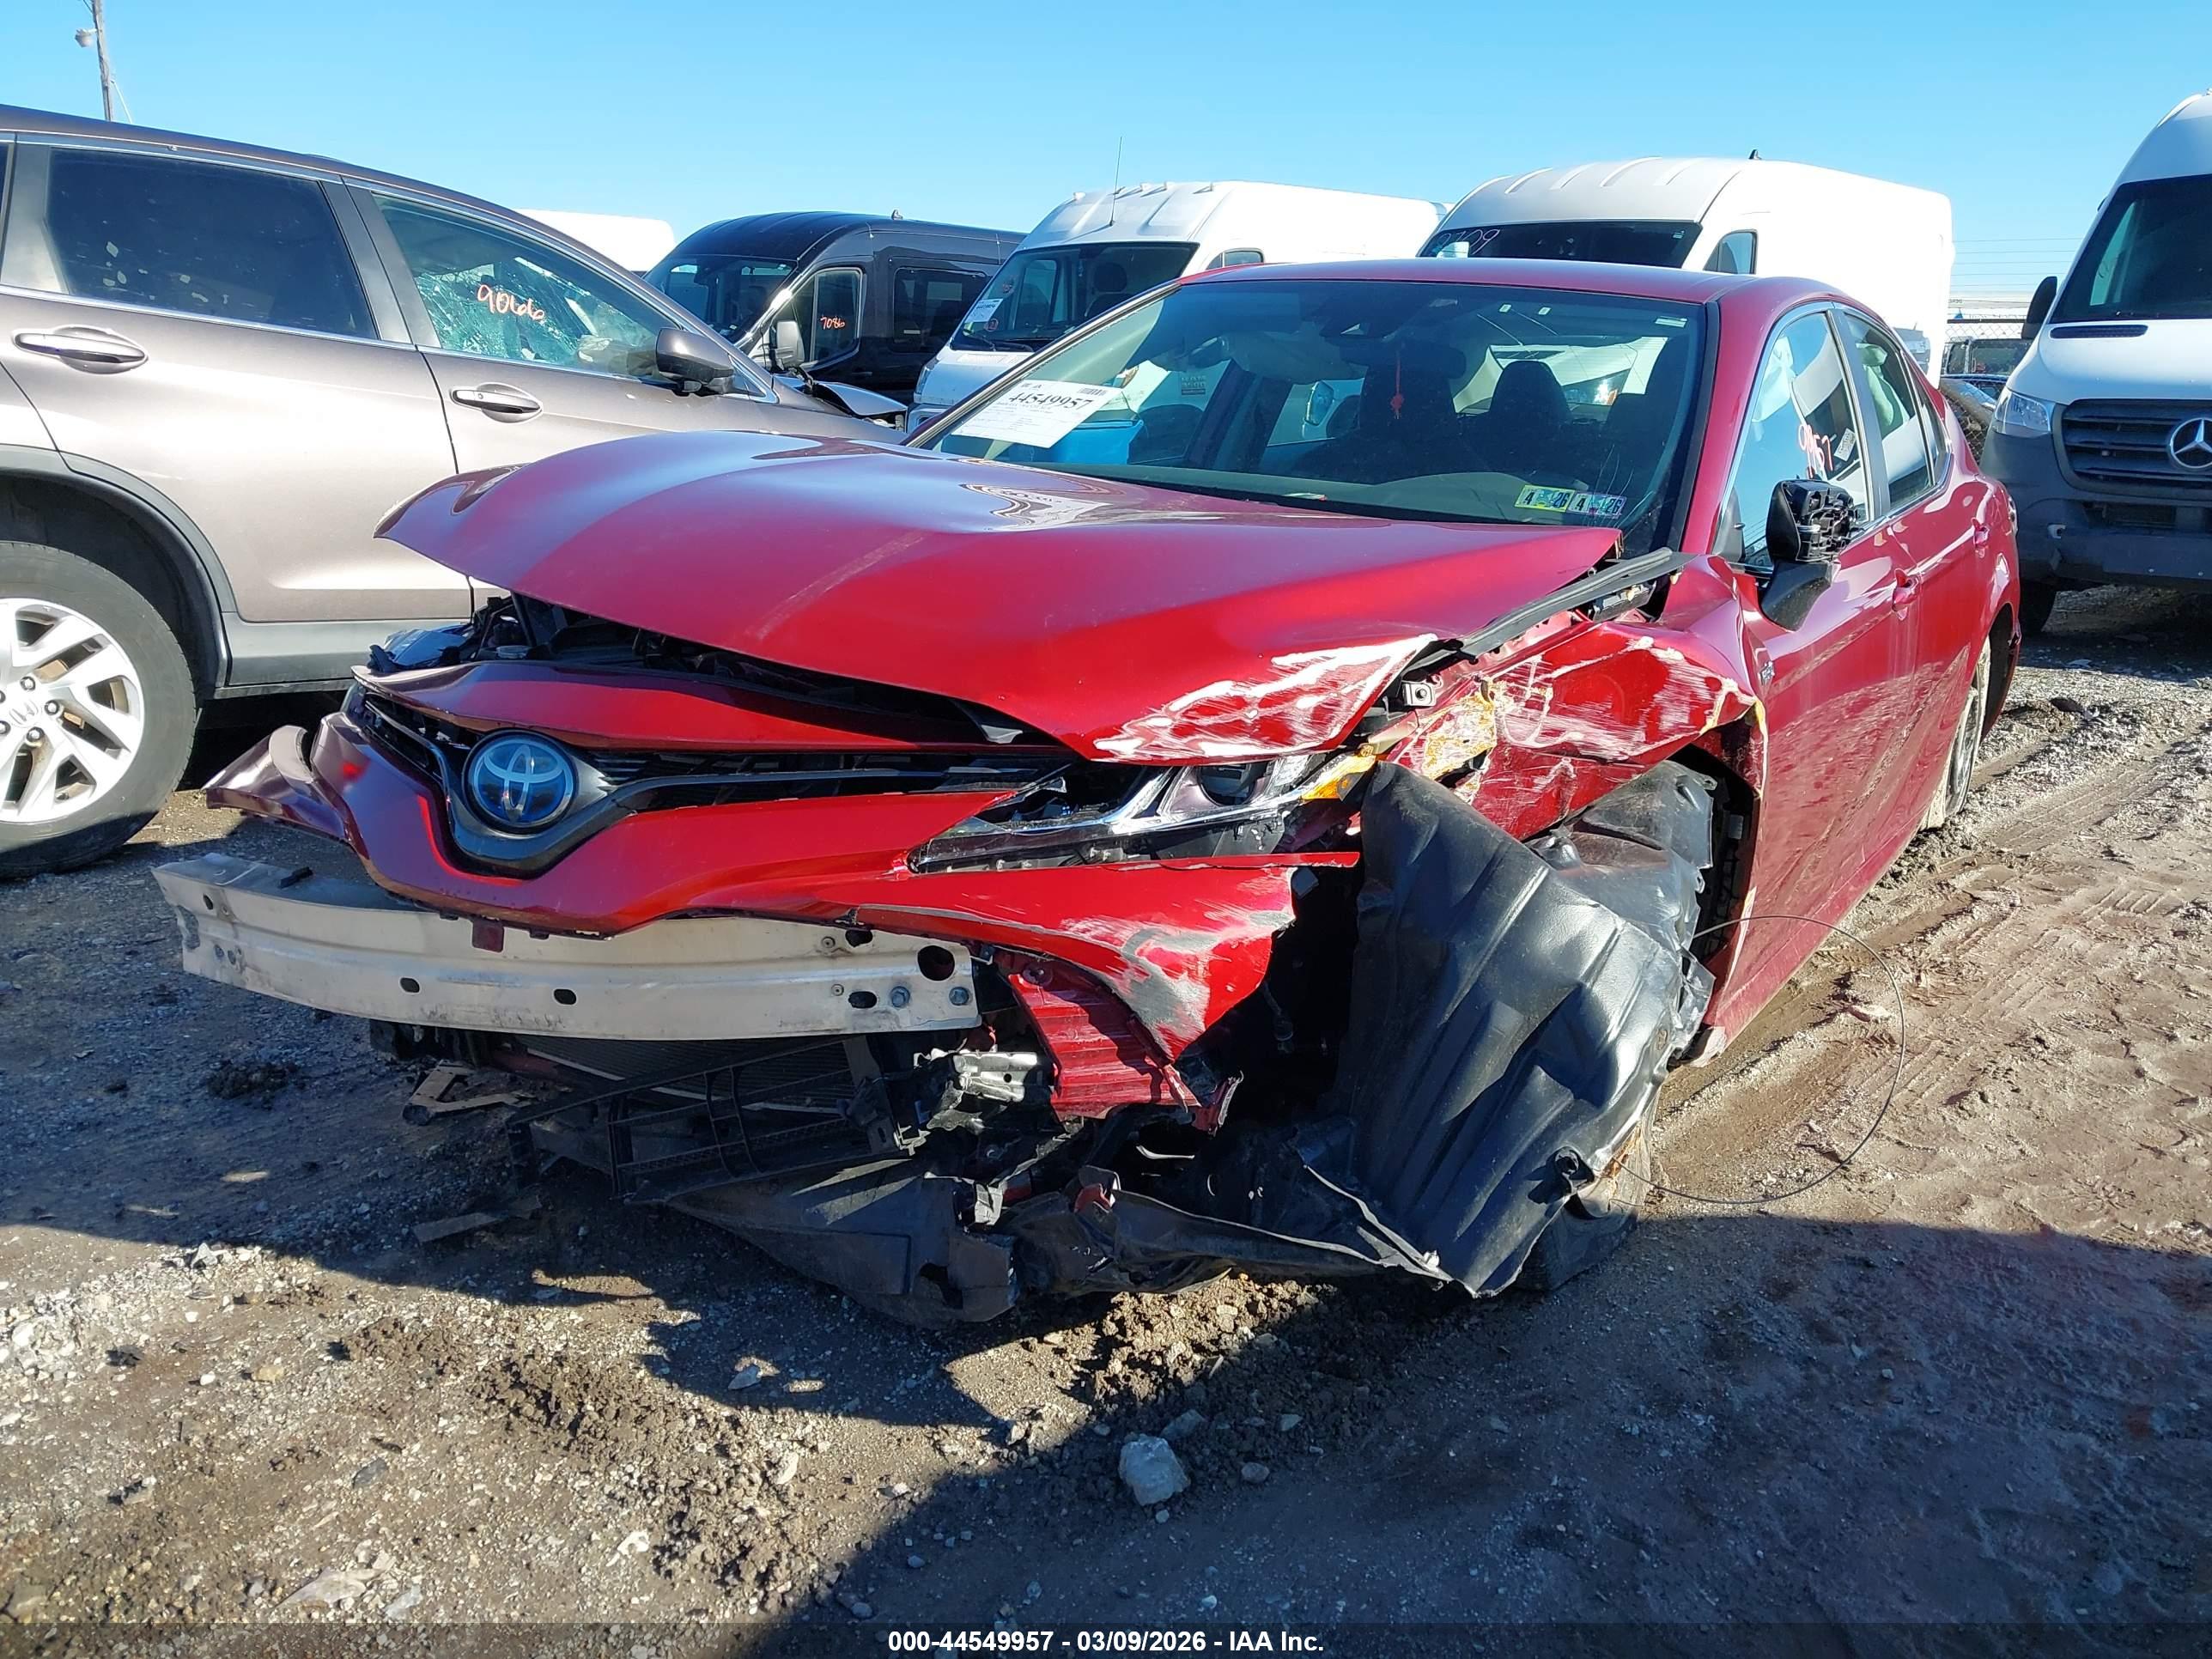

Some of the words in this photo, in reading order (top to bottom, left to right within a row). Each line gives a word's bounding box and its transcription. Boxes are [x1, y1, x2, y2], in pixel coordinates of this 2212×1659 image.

[477, 284, 545, 321] 9066
[820, 315, 846, 331] 7086
[1008, 392, 1095, 410] 44549957
[1524, 492, 1535, 505] 4
[1553, 492, 1571, 508] 26
[1575, 498, 1586, 511] 4
[1604, 499, 1622, 514] 26
